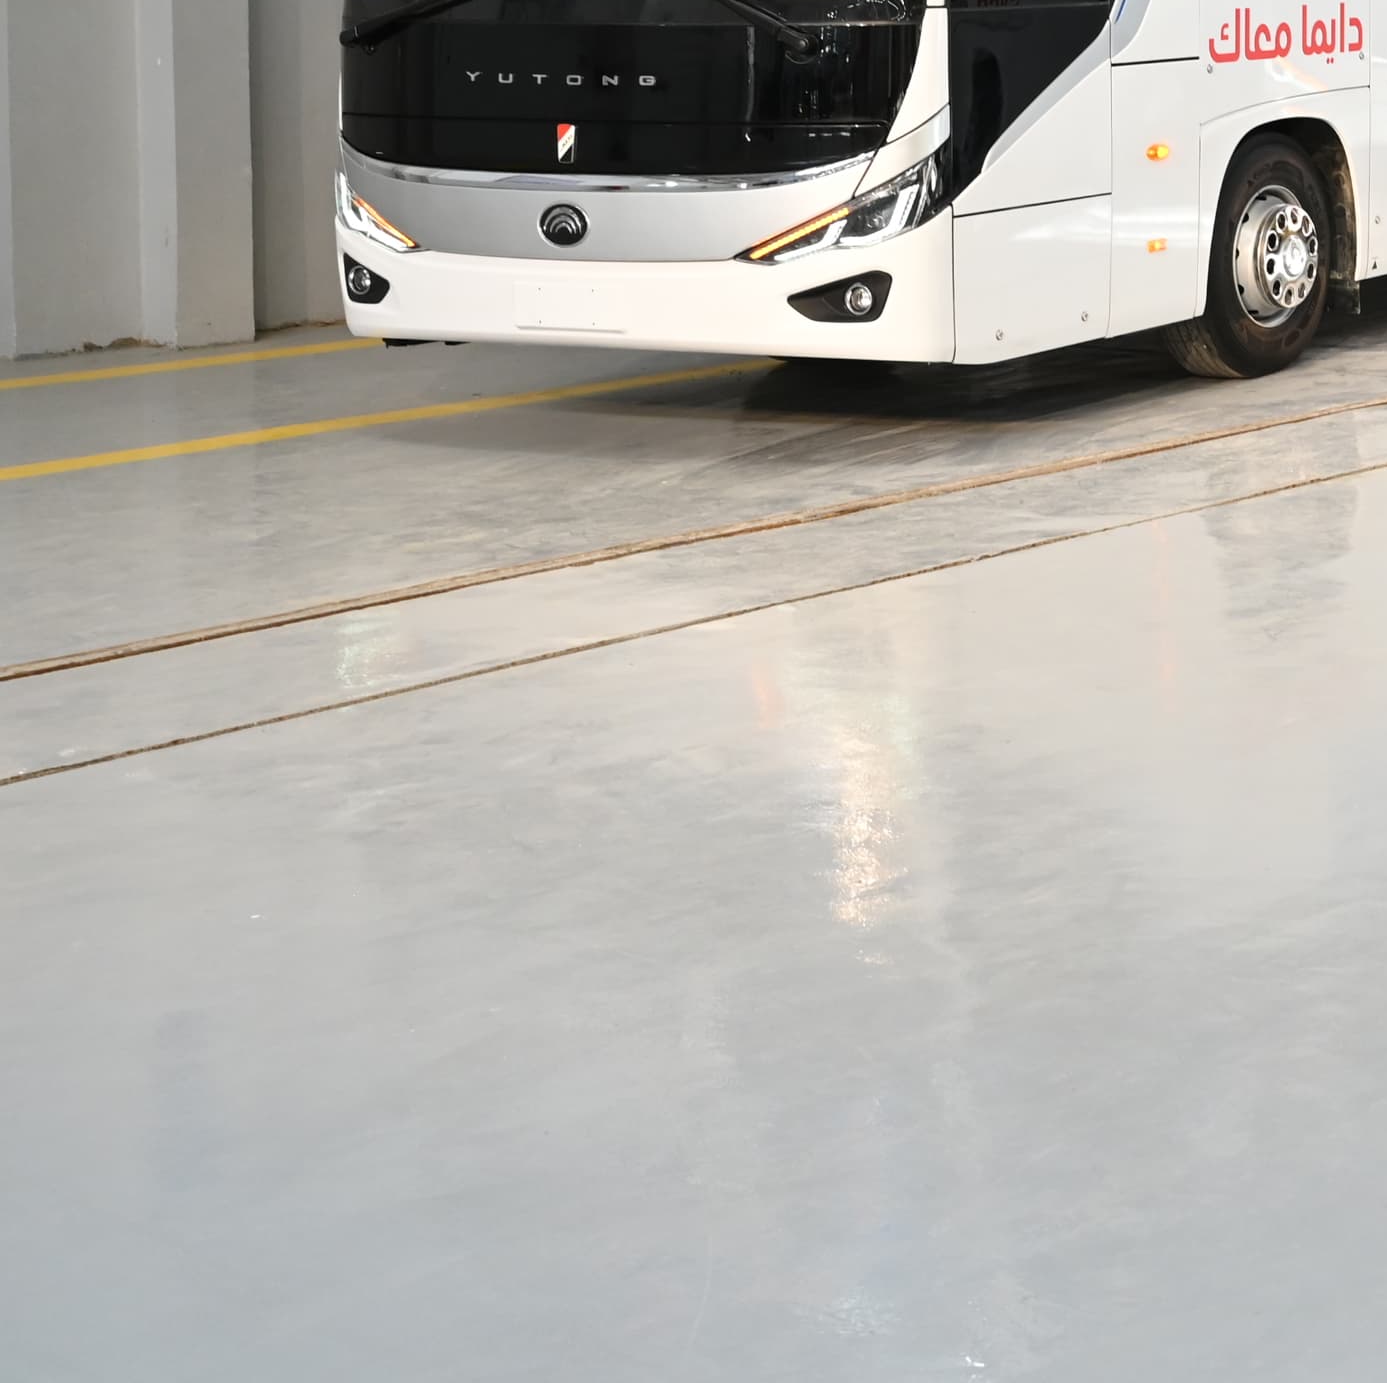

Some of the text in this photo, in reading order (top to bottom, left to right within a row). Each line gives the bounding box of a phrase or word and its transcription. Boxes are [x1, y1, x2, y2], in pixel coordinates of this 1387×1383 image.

[1208, 2, 1364, 66] دايما معاك
[465, 70, 657, 86] YUTONG
